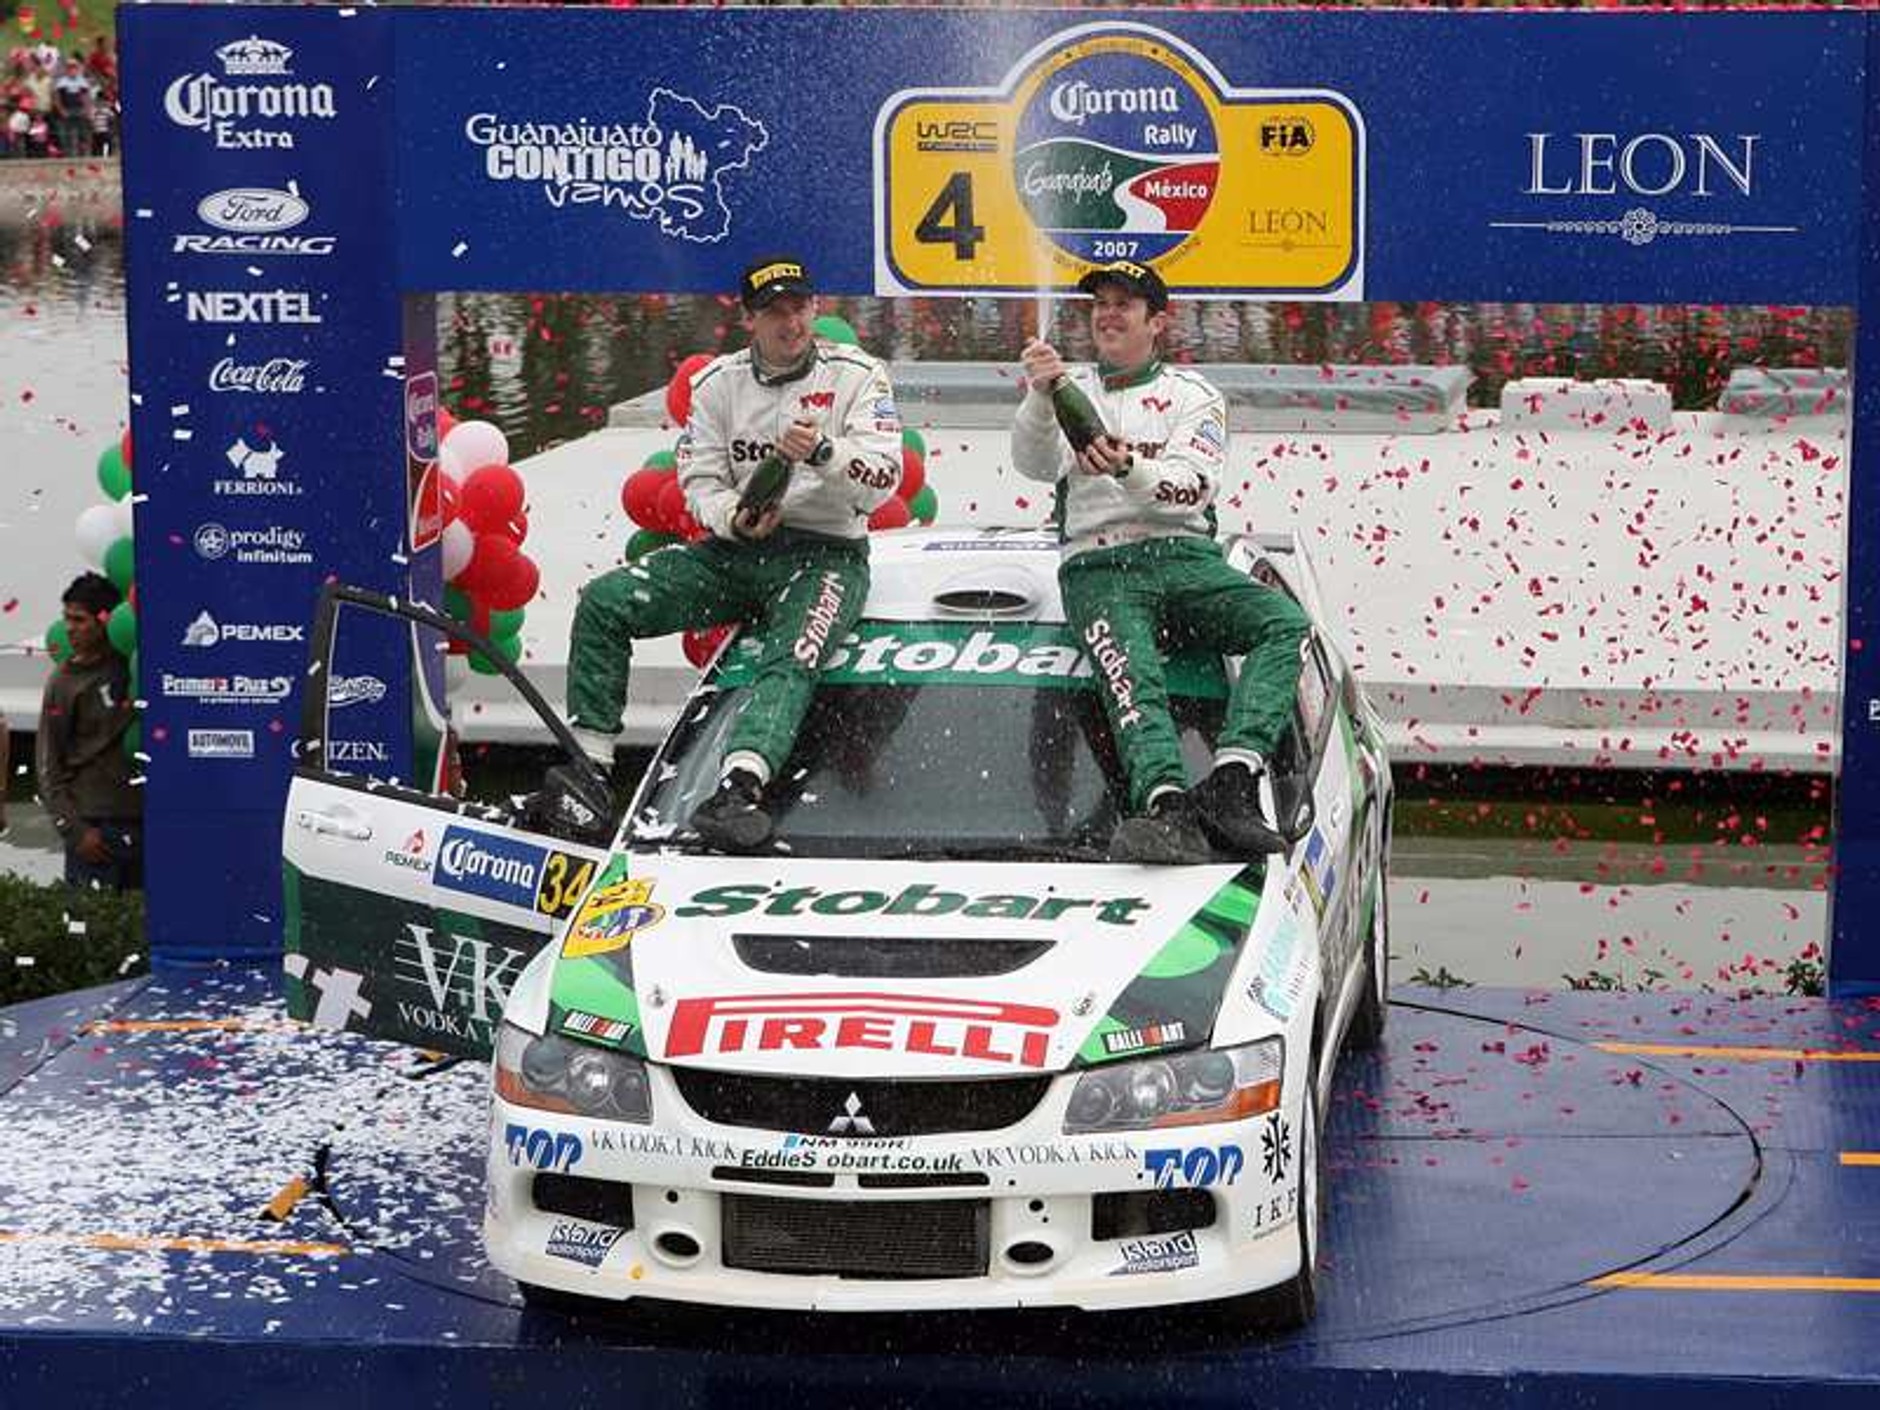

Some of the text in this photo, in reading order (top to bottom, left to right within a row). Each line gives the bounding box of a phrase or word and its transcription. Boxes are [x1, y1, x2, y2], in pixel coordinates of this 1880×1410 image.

[164, 73, 337, 132] Corona
[1051, 81, 1179, 126] Corona
[217, 122, 293, 148] Extra
[466, 113, 663, 147] Guanajuato
[1144, 124, 1197, 148] Rally
[486, 145, 660, 181] CONTIGO
[1522, 133, 1761, 197] LEON
[1144, 179, 1207, 198] México
[222, 196, 283, 222] Ford
[915, 172, 984, 260] 4
[173, 235, 337, 255] RACING
[1093, 242, 1139, 257] 2007
[187, 291, 322, 322] NEXTEL
[214, 482, 295, 494] FERRIONI
[231, 527, 305, 549] prodigy
[238, 548, 312, 564] infinitum
[221, 624, 306, 641] PEMEX
[794, 572, 844, 669] Stobart
[1086, 619, 1142, 730] Stobart
[441, 838, 535, 890] Corona
[540, 852, 594, 913] 34
[674, 882, 1154, 926] Stobart
[405, 922, 525, 1023] VK
[399, 1002, 479, 1042] VODKA
[664, 992, 1060, 1068] PIRELLI
